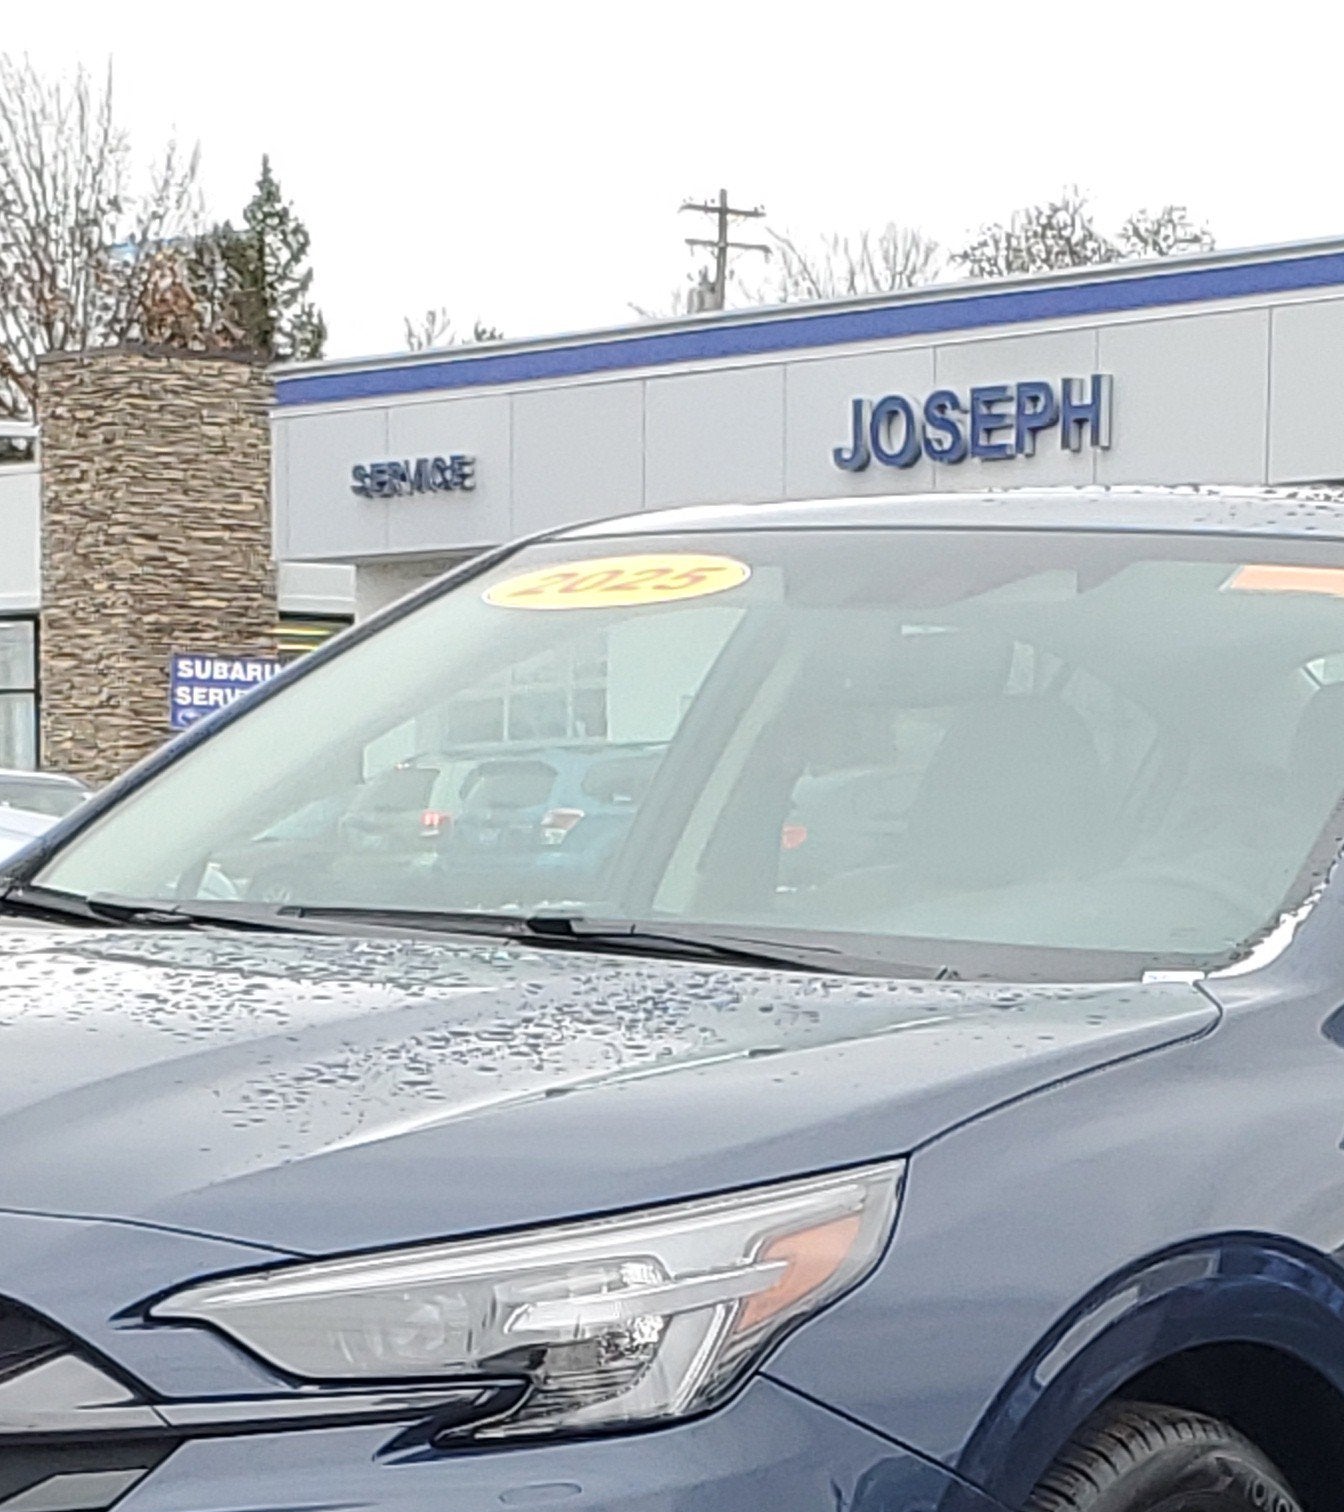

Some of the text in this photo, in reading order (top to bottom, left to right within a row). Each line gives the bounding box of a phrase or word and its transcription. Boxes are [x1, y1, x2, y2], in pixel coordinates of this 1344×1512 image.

[833, 374, 1113, 471] JOSEPH
[351, 455, 476, 498] SERVICE
[507, 567, 727, 597] 2025
